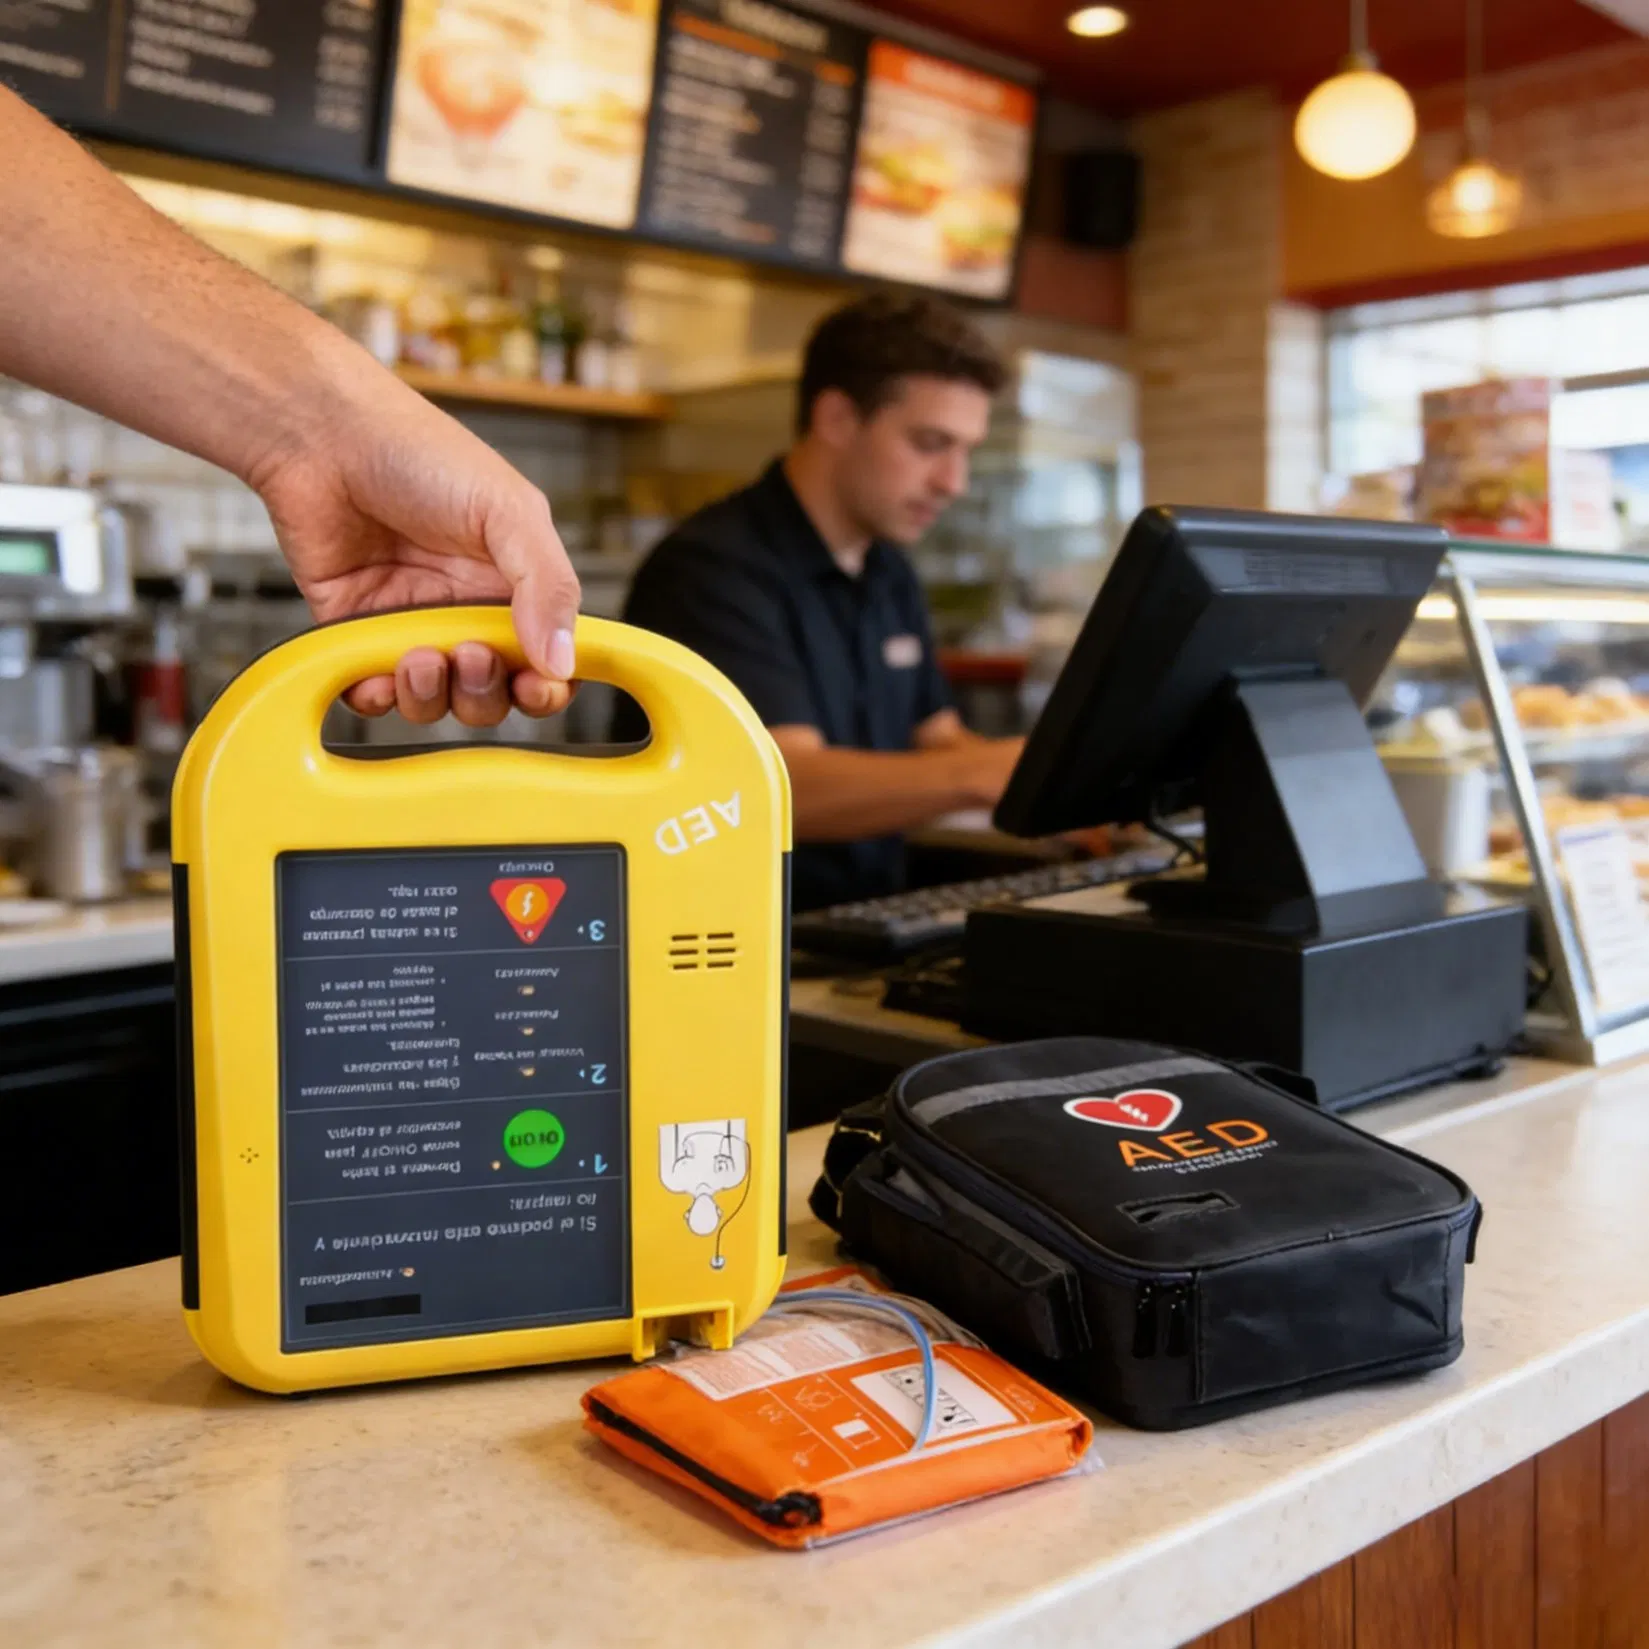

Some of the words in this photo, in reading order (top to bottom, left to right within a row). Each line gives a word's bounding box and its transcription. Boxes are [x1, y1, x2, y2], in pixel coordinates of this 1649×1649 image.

[654, 790, 741, 856] AED
[589, 919, 606, 941] 3
[590, 1064, 608, 1085] 2
[1118, 1120, 1269, 1167] AED
[594, 1153, 608, 1175] 1
